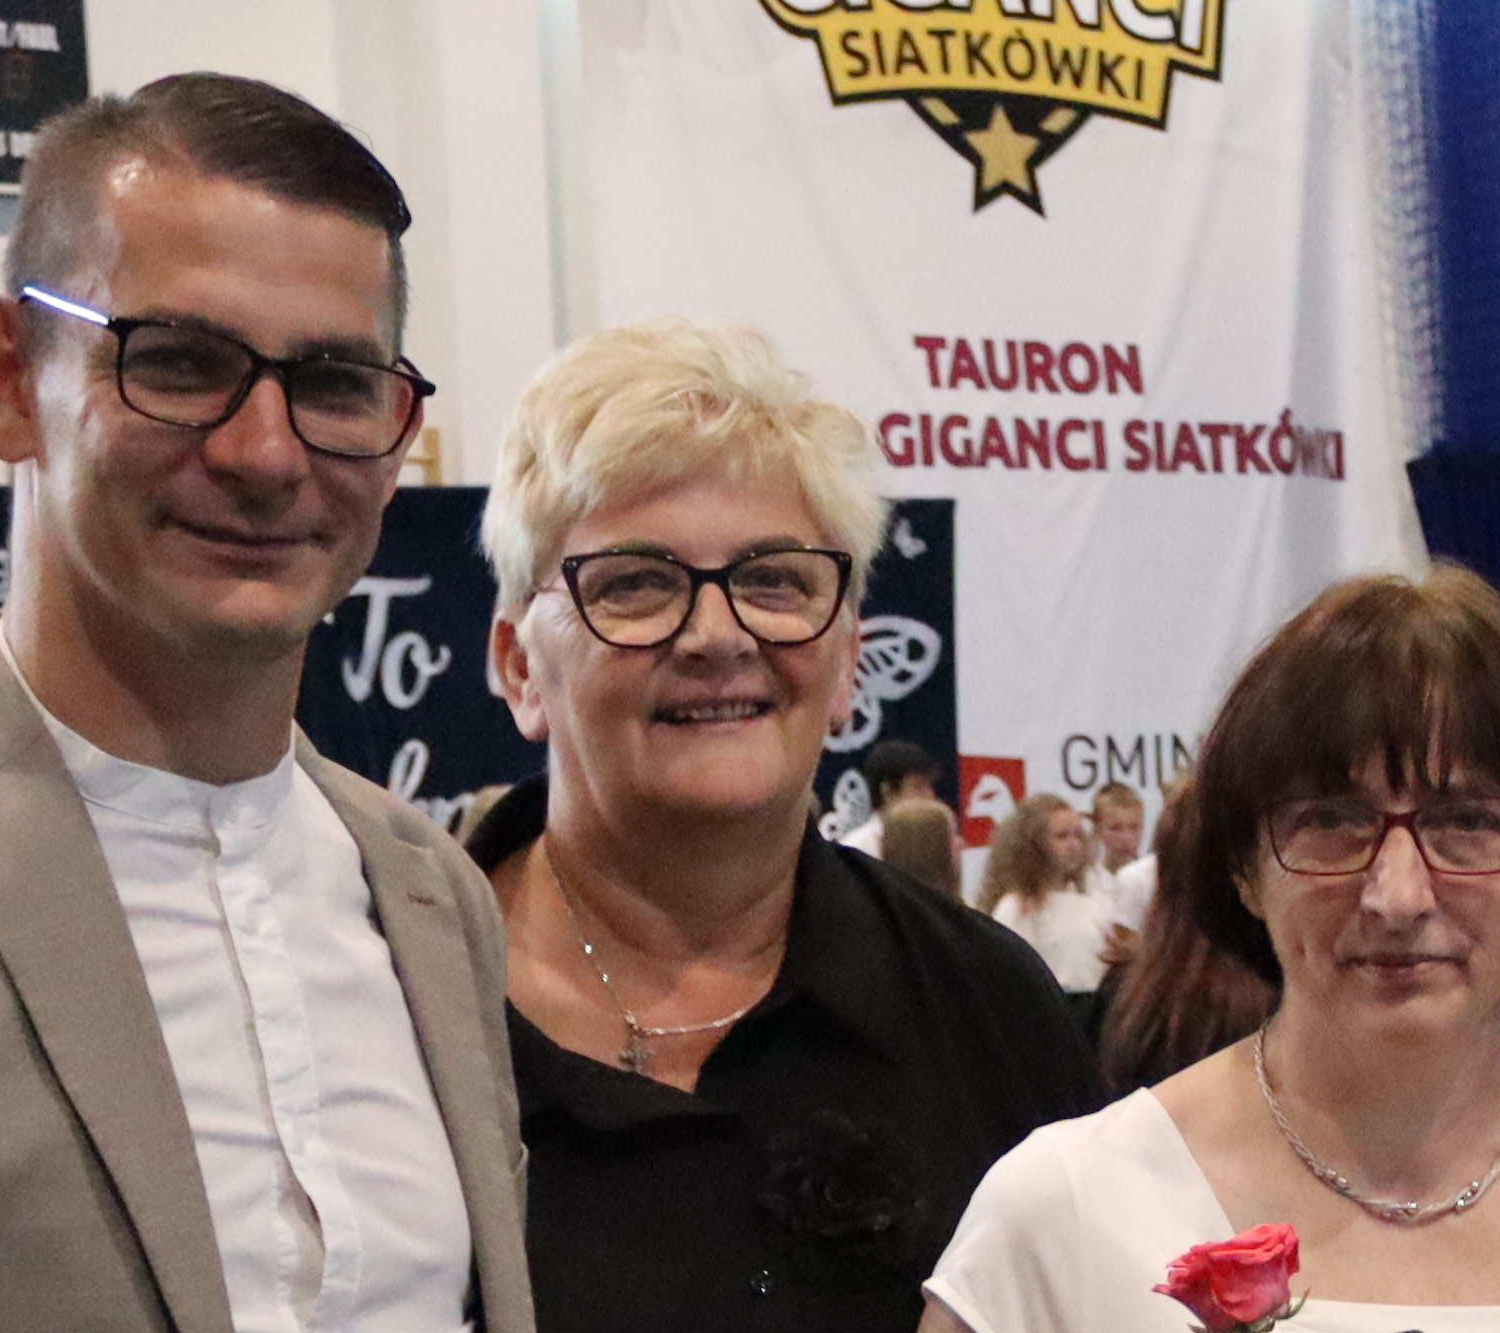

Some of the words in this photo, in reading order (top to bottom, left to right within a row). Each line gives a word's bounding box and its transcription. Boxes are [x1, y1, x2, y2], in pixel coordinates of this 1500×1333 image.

[840, 28, 1143, 101] SIATKÓWKI
[913, 335, 1144, 395] TAURON
[876, 412, 1108, 471] GIGANCI
[1123, 406, 1344, 481] SIATKÓI
[342, 575, 452, 710] To
